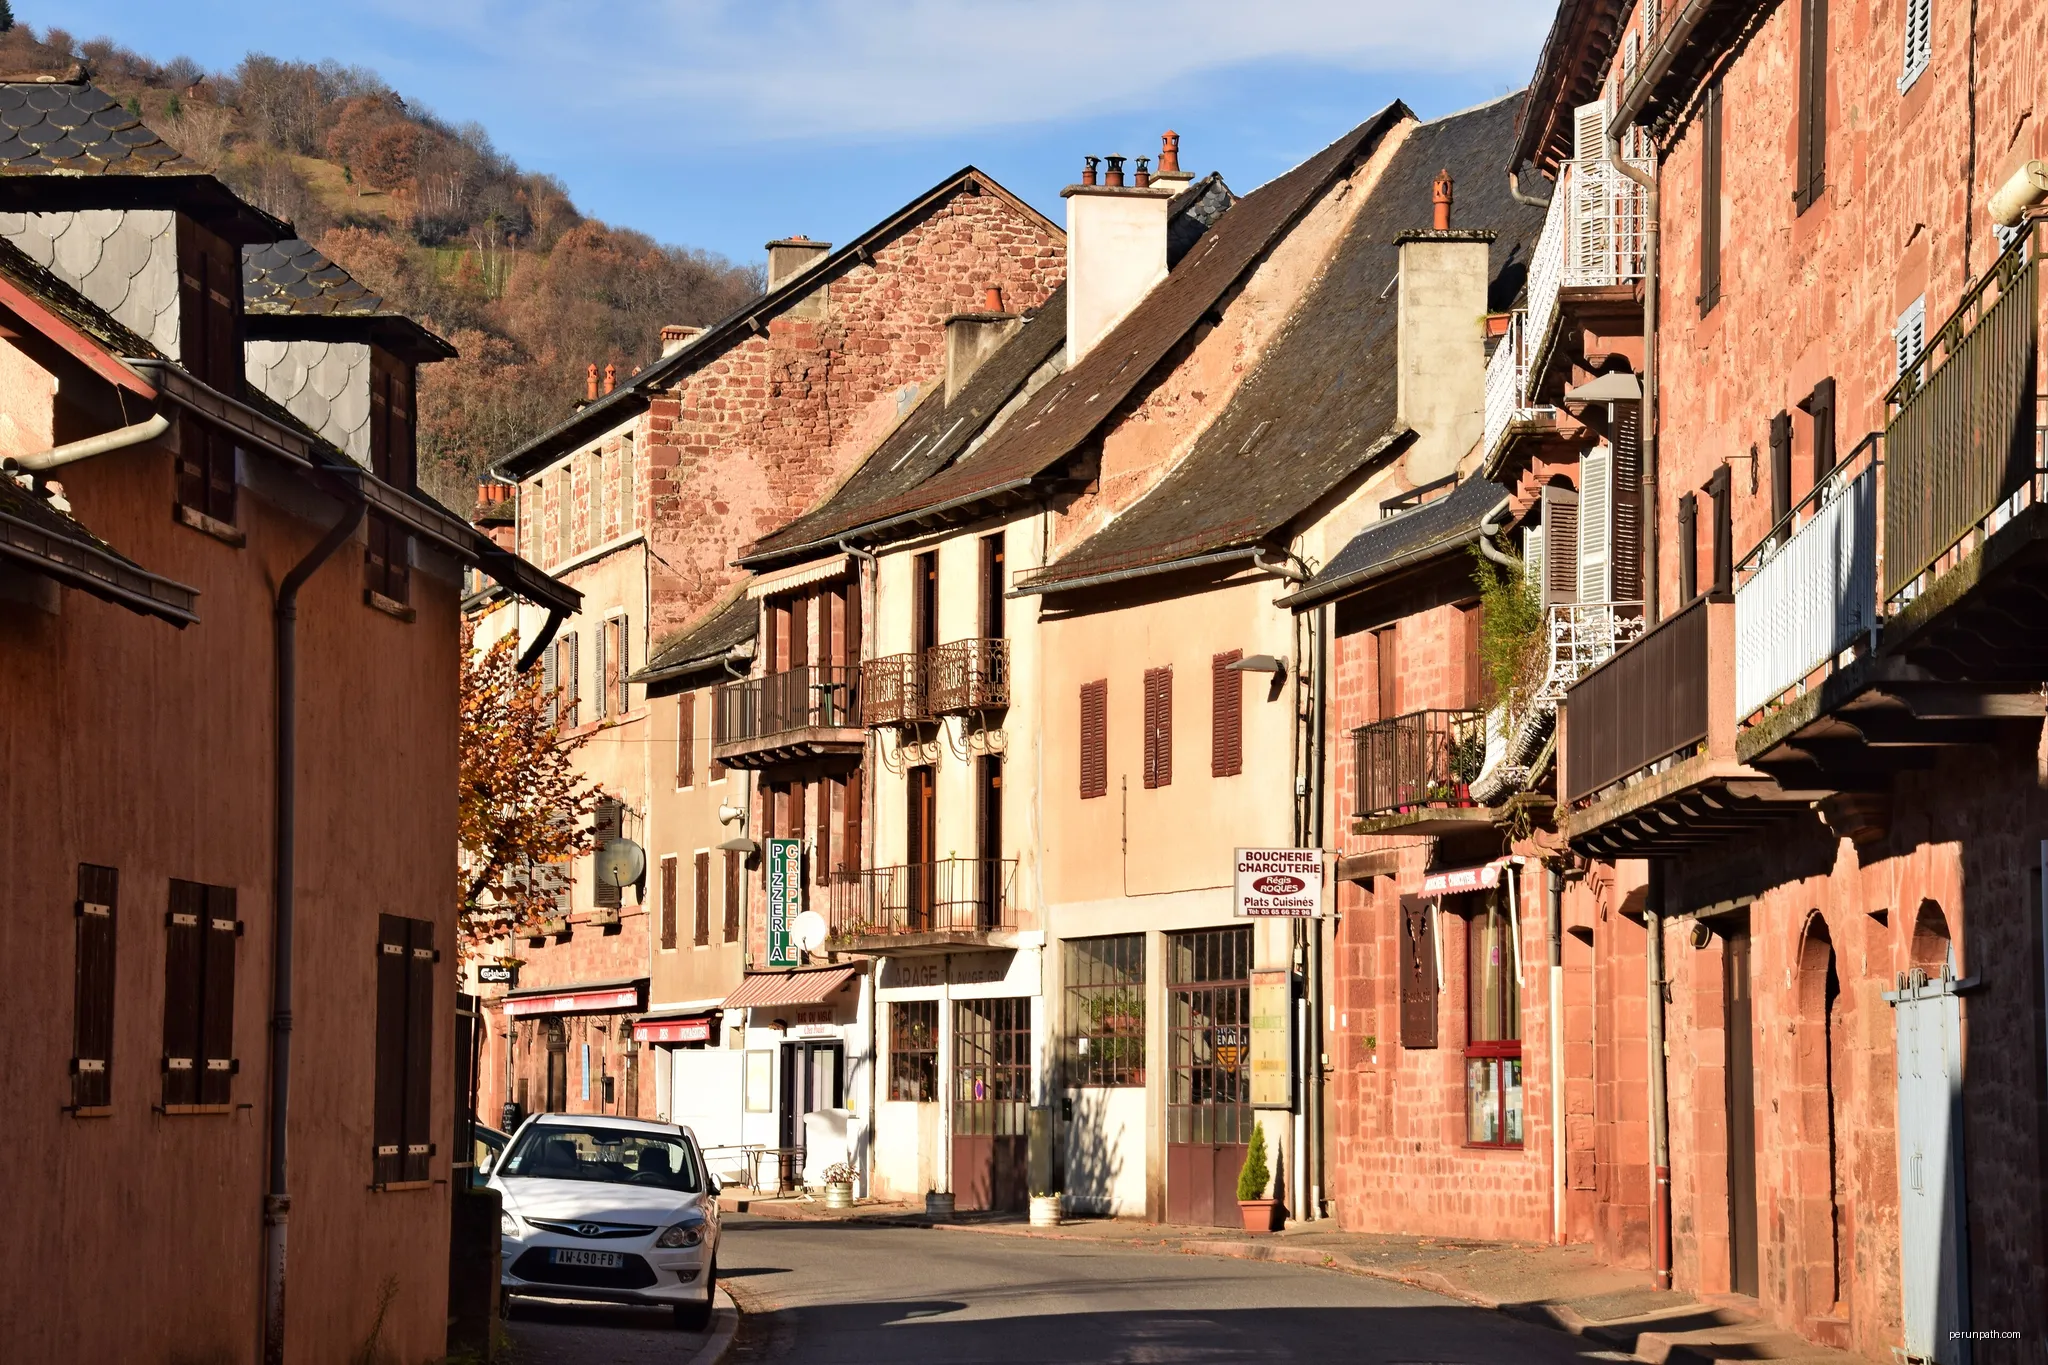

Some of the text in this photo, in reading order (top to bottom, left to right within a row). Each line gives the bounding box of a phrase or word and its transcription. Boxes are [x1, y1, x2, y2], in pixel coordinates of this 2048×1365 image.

[1245, 851, 1313, 862] BOUCHERIE
[1238, 863, 1321, 873] CHARCUTERIE
[1266, 876, 1291, 885] Régis
[1260, 885, 1299, 893] ROQUES
[770, 844, 784, 961] PIZZERIA
[1244, 897, 1314, 907] Plats Cuisinés
[480, 968, 510, 980] Carlsberg
[559, 1250, 614, 1266] AW-490-FB
